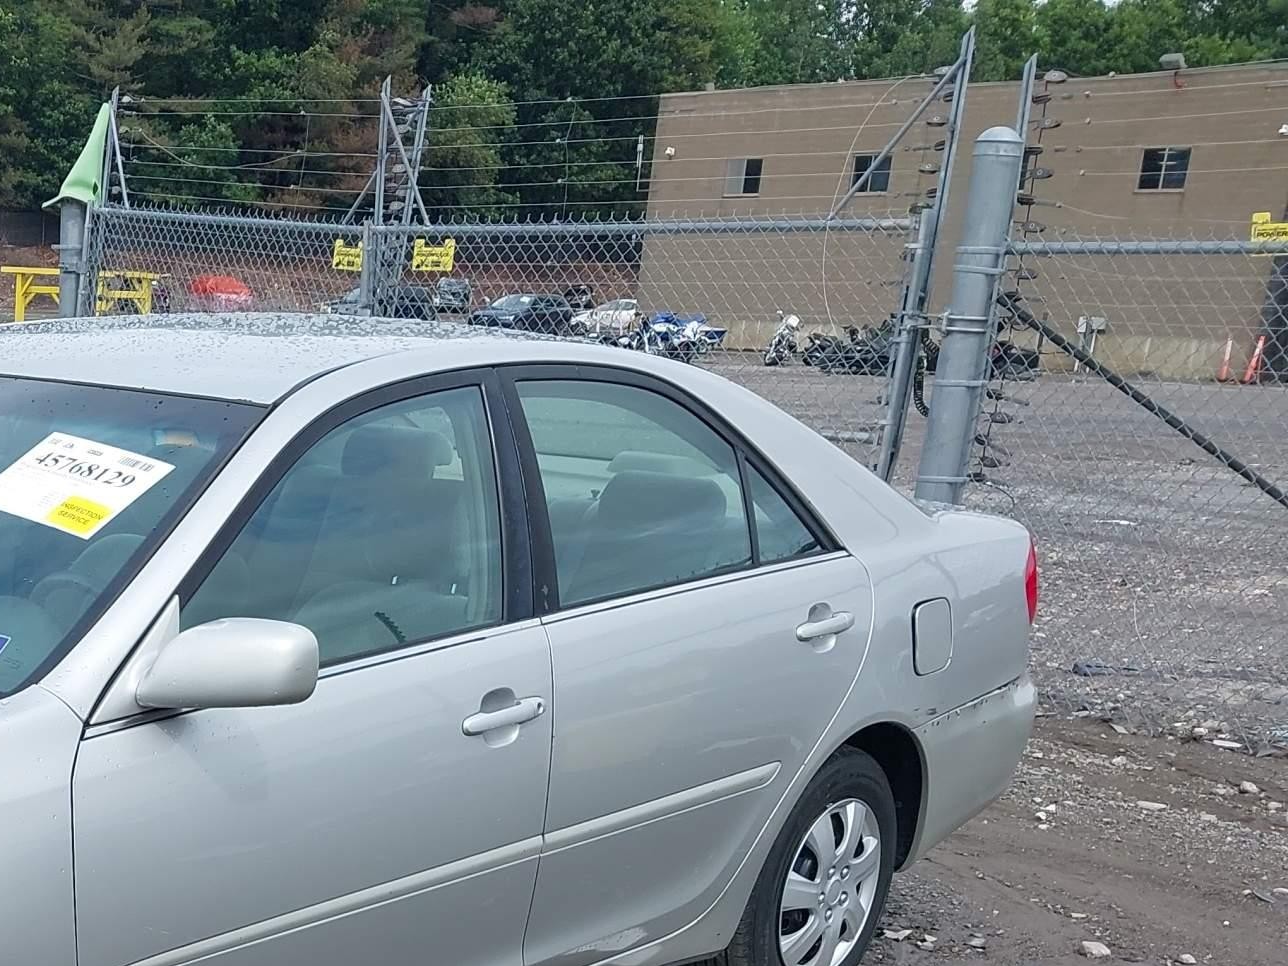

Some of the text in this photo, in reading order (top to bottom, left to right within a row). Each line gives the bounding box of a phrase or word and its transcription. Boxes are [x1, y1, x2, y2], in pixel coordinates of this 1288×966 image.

[34, 450, 137, 488] 45768129
[57, 510, 90, 527] SERVICE
[60, 501, 105, 522] INSPECTION
